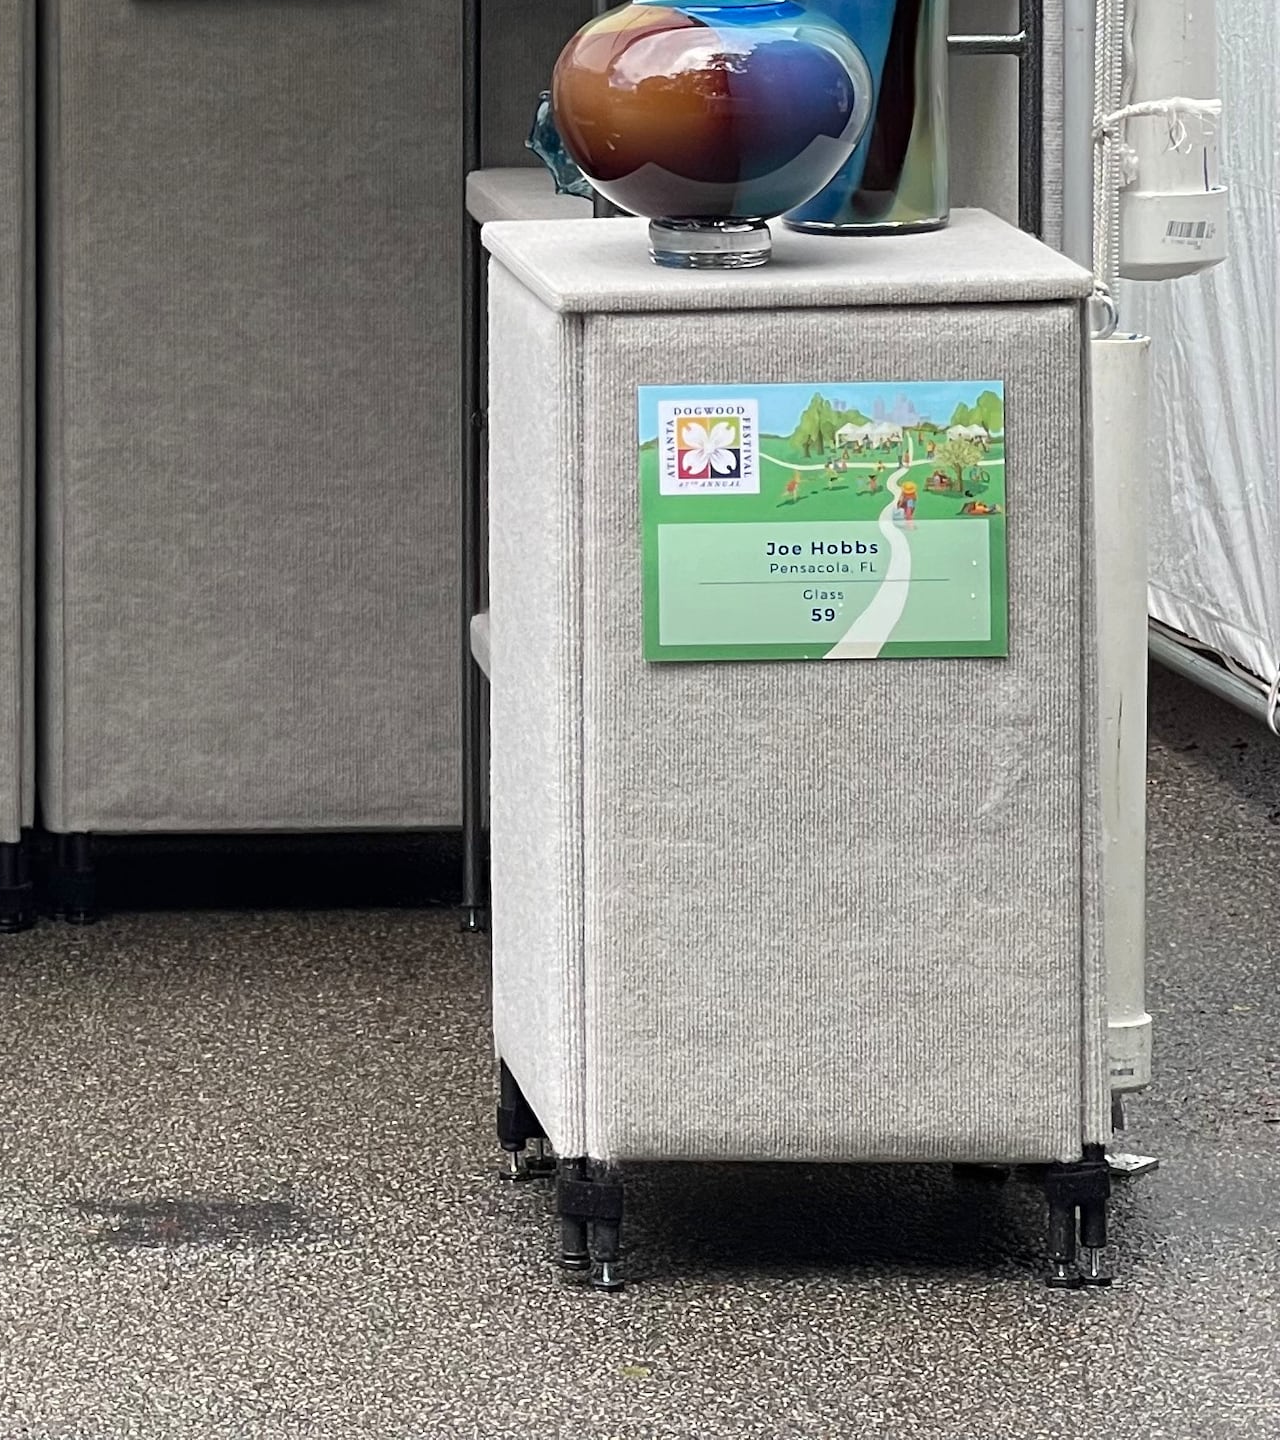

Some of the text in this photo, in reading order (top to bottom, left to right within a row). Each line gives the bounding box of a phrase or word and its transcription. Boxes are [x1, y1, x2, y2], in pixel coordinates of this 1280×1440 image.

[673, 406, 745, 415] DOGWOOD
[666, 420, 676, 478] ATLANTA
[742, 417, 752, 479] FESTIVAL
[766, 540, 879, 556] Joe Hobbs
[770, 562, 877, 574] Pensacola, FL
[803, 589, 844, 600] Glass
[811, 608, 835, 622] 59
